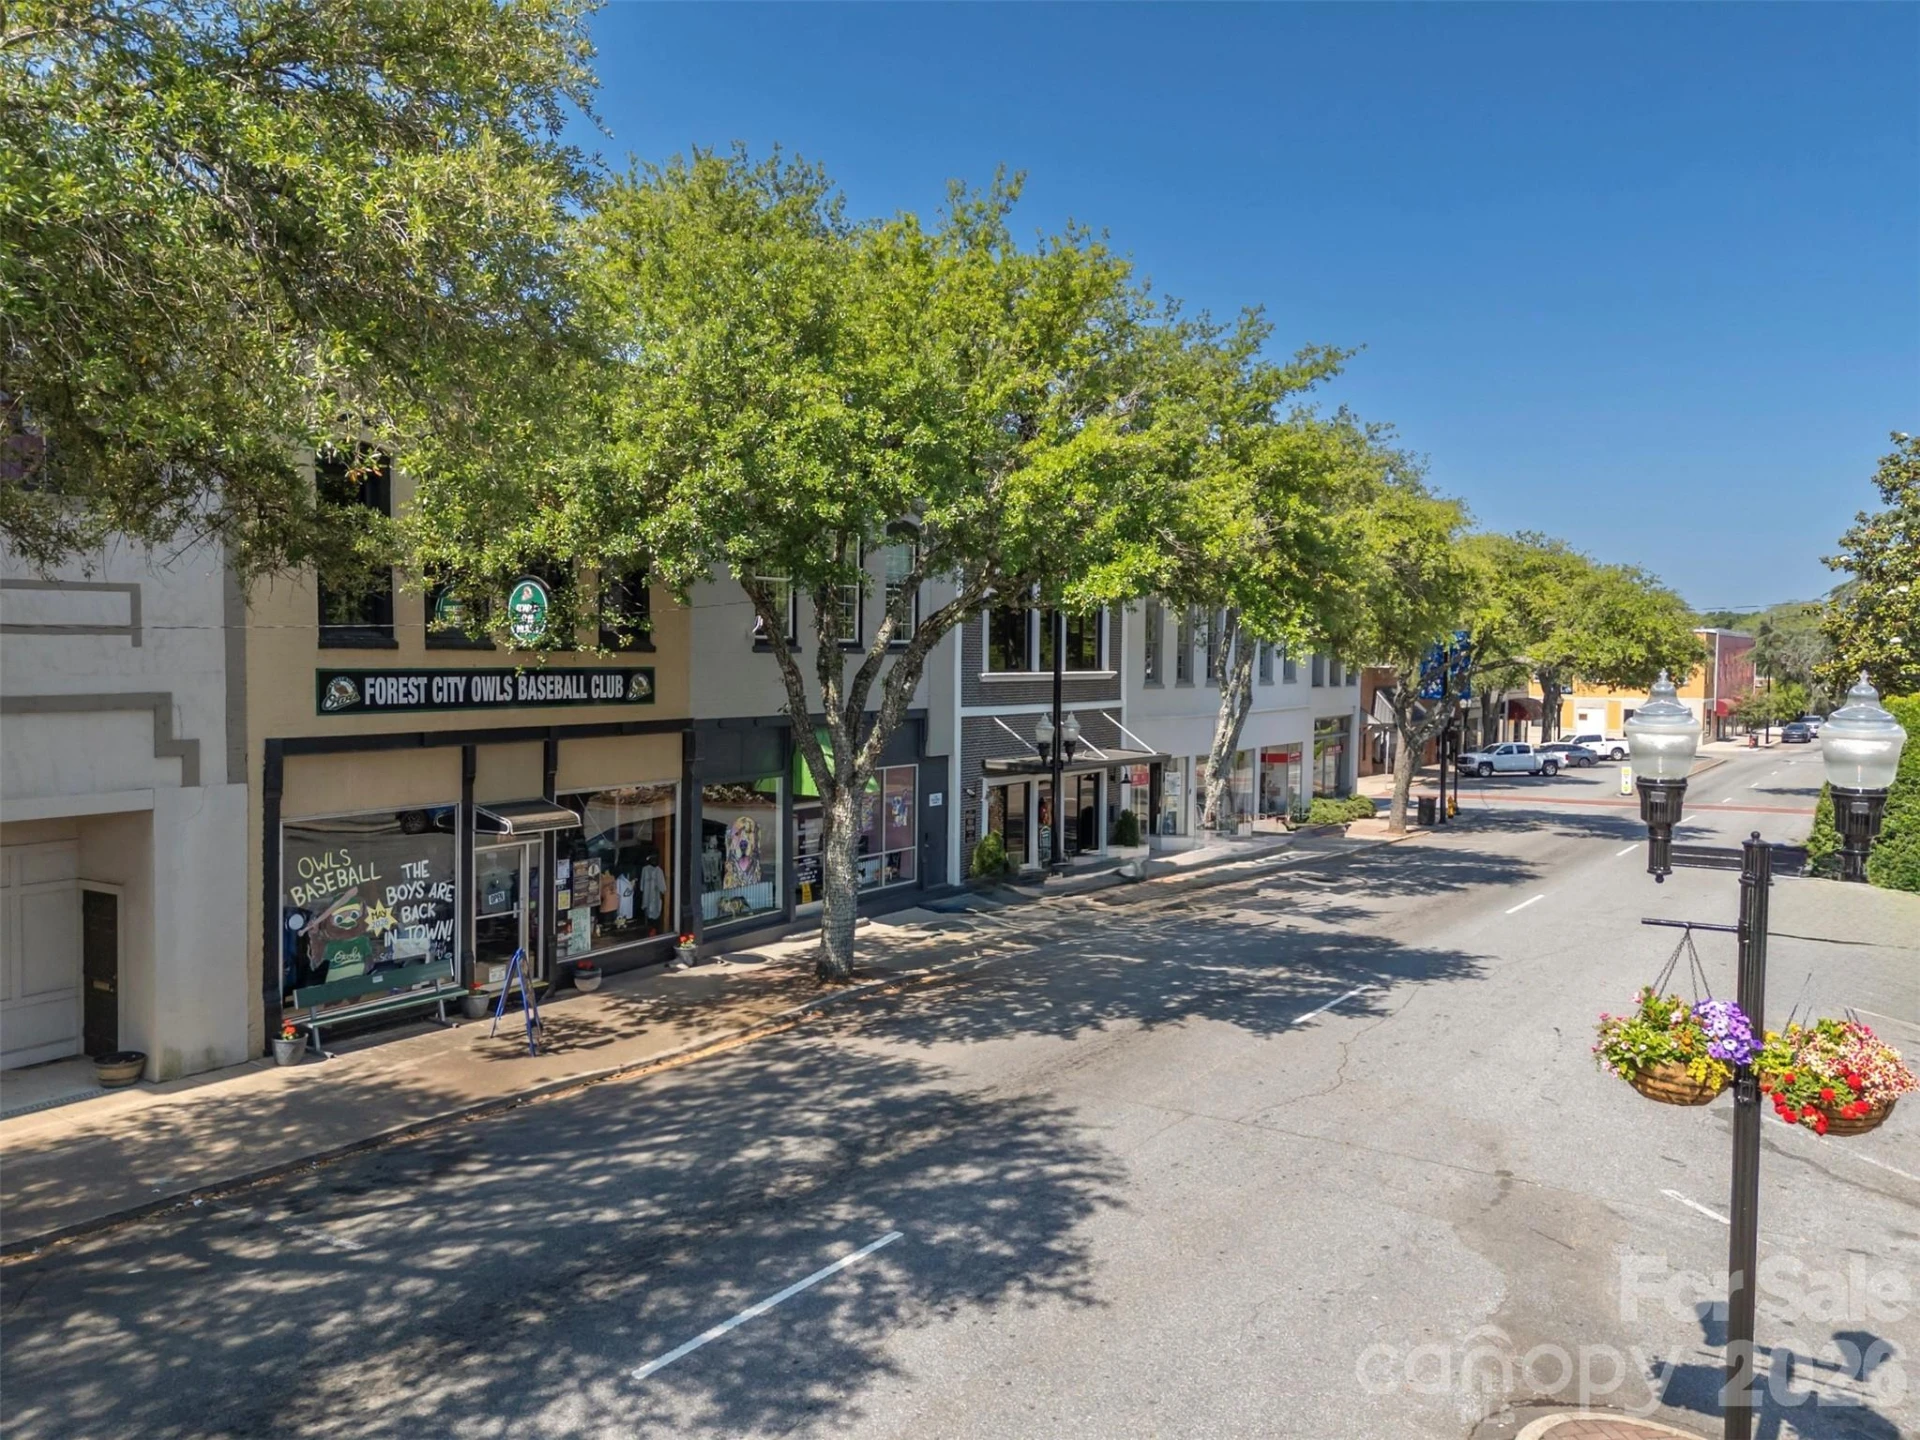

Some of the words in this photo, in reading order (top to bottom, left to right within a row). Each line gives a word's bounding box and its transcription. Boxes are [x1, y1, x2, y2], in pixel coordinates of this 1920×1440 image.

[364, 676, 428, 706] FOREST
[432, 676, 467, 704] CITY
[471, 675, 513, 703] OWLS
[517, 673, 588, 702] BASEBALL
[591, 674, 624, 699] CLUB
[297, 848, 352, 879] OWLS
[400, 859, 430, 879] THE
[290, 861, 382, 907] BASEBALL
[385, 880, 426, 906] BOYS
[428, 881, 455, 902] ARE
[371, 909, 388, 920] MAY
[401, 902, 436, 923] BACK
[384, 928, 398, 947] IN
[404, 918, 454, 945] TOWN!
